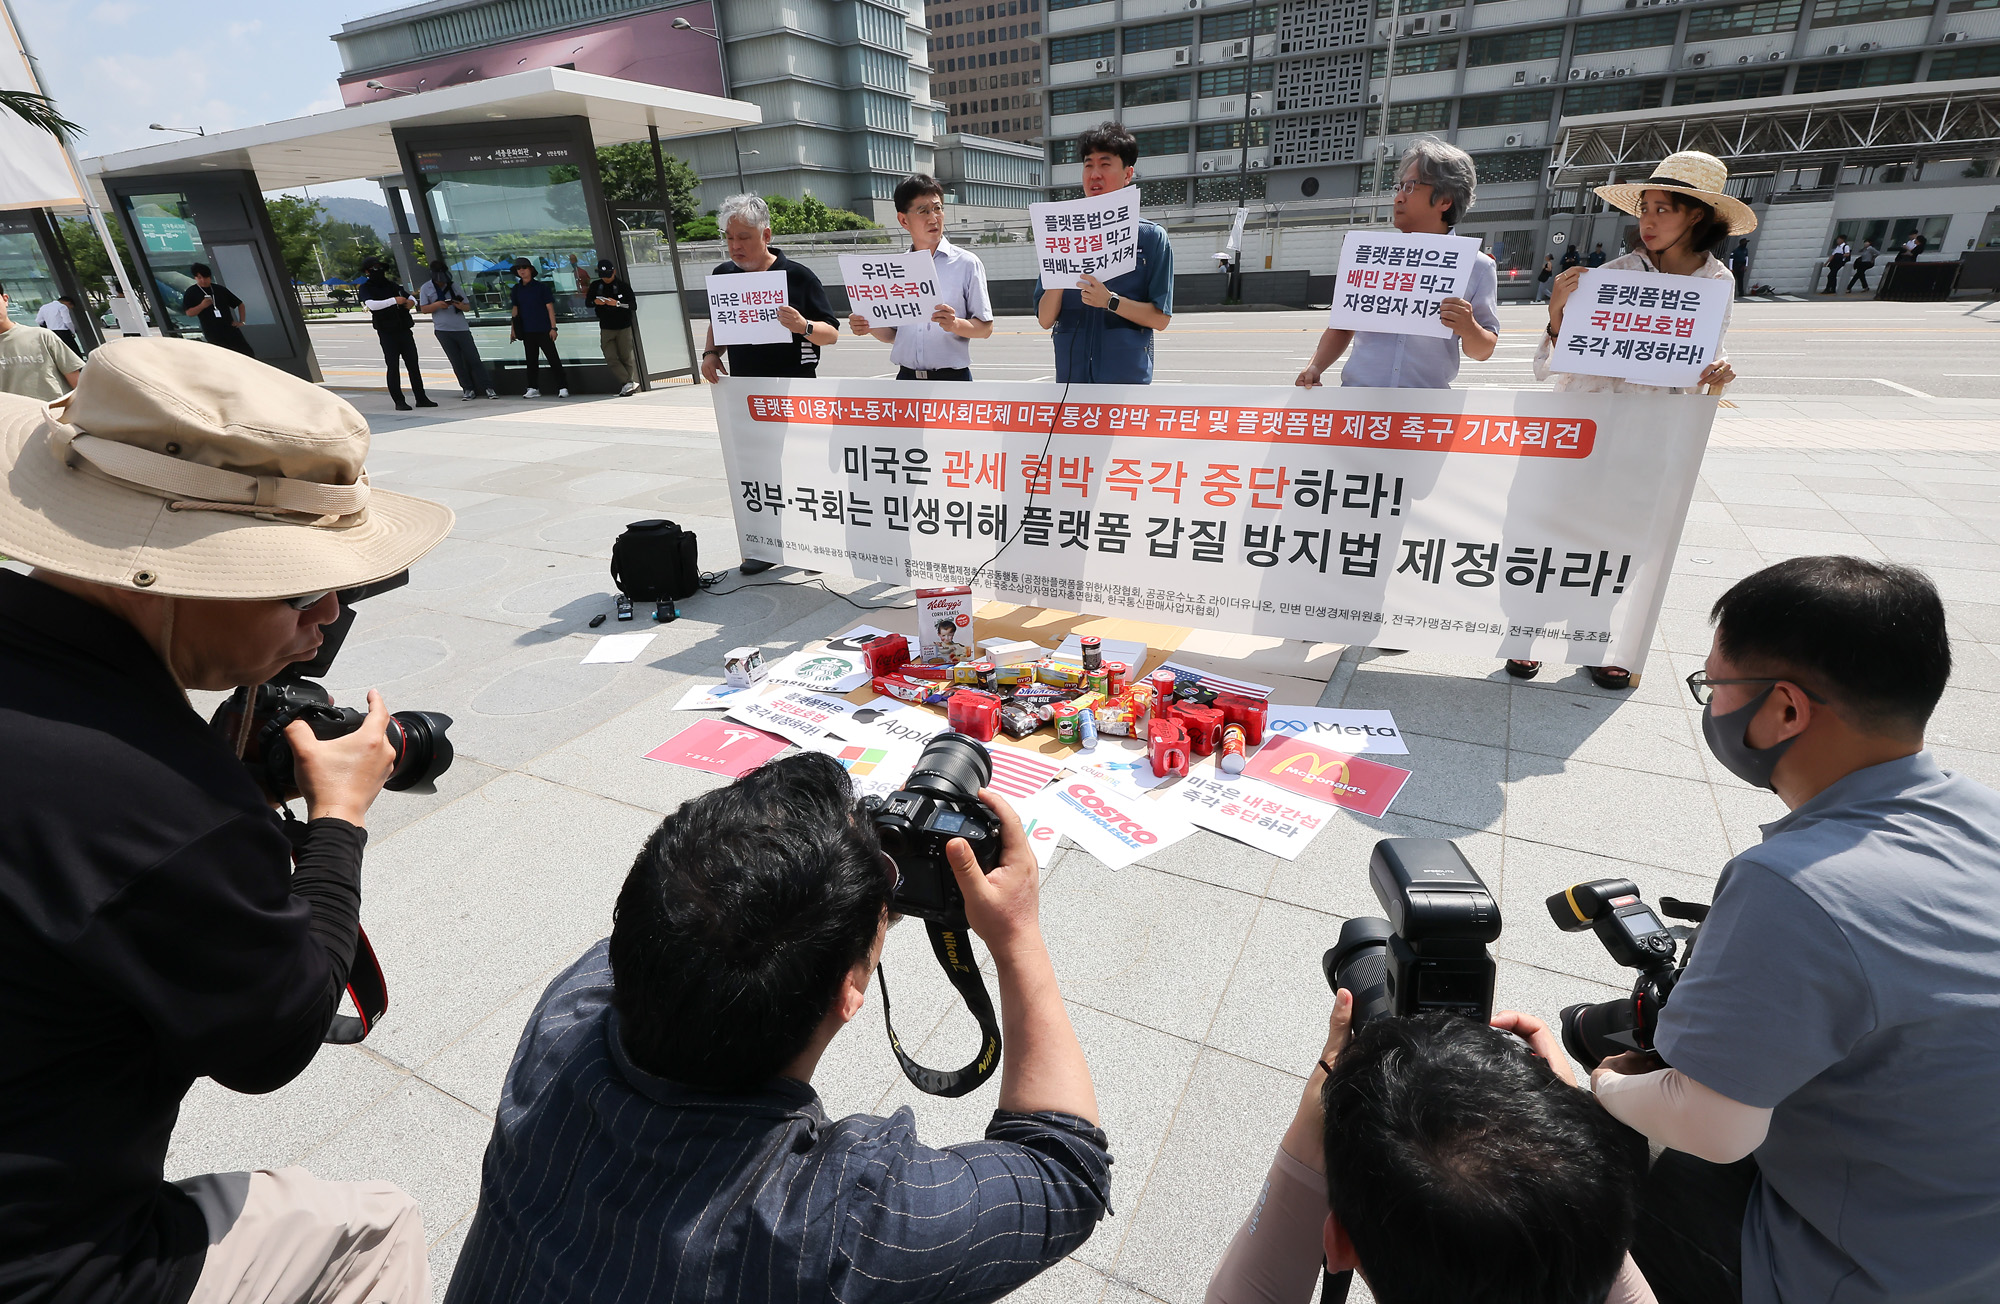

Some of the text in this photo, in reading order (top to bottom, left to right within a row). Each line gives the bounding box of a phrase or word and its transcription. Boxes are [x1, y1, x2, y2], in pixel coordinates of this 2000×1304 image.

[1045, 205, 1130, 232] 플랫폼법으로
[1045, 226, 1132, 254] 쿠팡 갑질 막고
[862, 262, 906, 280] 우리는
[1042, 243, 1135, 275] 택배노동자 지켜
[1355, 244, 1460, 270] 플랫폼법으로
[847, 280, 936, 301] 미국의 속국이
[1347, 269, 1455, 294] 배민 갑질 막고
[711, 289, 785, 307] 미국은 내정간섭
[872, 302, 922, 320] 아니다!
[1343, 293, 1409, 317] 자영업자
[1597, 283, 1701, 312] 플랫폼법은
[717, 310, 737, 325] 즉각
[1590, 310, 1696, 338] 국민보호법
[1567, 334, 1705, 366] 즉각 제정하라!
[753, 397, 795, 418] 플랫폼
[1018, 404, 1056, 427] 미국
[1061, 406, 1102, 429] 통상
[1108, 407, 1151, 431] 압박
[1155, 409, 1200, 432] 규탄
[1208, 410, 1229, 434] 및
[1237, 410, 1334, 438] 플랫폼법
[1340, 414, 1392, 441] 제정
[1400, 416, 1454, 444] 촉구
[1463, 418, 1582, 450] 기자회견
[844, 444, 1404, 519] 미국은 관세 협박 즉각 중단하라!
[740, 480, 1632, 597] 정부·국회는 민생위해 플랫폼 갑질 방지법 제정하라!
[785, 540, 798, 550] 오전
[813, 545, 844, 558] 광화문광장
[844, 549, 858, 560] 미국
[858, 552, 879, 564] 대사관
[880, 555, 894, 566] 인근
[905, 569, 1220, 618] 참여연대 민생희망본부, 한국중소상인자영업자총연합회, 한국통신판매사업자협회)
[927, 598, 962, 611] Kellogg's
[1146, 588, 1207, 605] 공공운수노조
[1208, 595, 1276, 613] 라이더유니온,
[1279, 602, 1301, 615] 민변
[1304, 604, 1388, 625] 민생경제위원회,
[1391, 613, 1505, 638] 전국가맹점주협의회,
[1509, 625, 1614, 644] 전국택배노동조합,
[767, 678, 840, 692] STARBUCKS
[770, 699, 830, 724] 국민보호법
[784, 692, 845, 715] 플랫폼법은
[745, 703, 821, 737] 즉각 제정하라!
[1313, 720, 1397, 738] Meta
[686, 752, 727, 765] TESLA
[1080, 765, 1122, 788] coupang
[1284, 766, 1368, 796] McDonald's
[1067, 783, 1158, 845] COSTCO
[1182, 788, 1299, 838] 즉각 중단하라
[1186, 776, 1322, 830] 미국은 내정간섭
[1080, 808, 1142, 850] WHOLESALE
[941, 931, 960, 965] Nikon
[978, 1036, 996, 1074] Nikon
